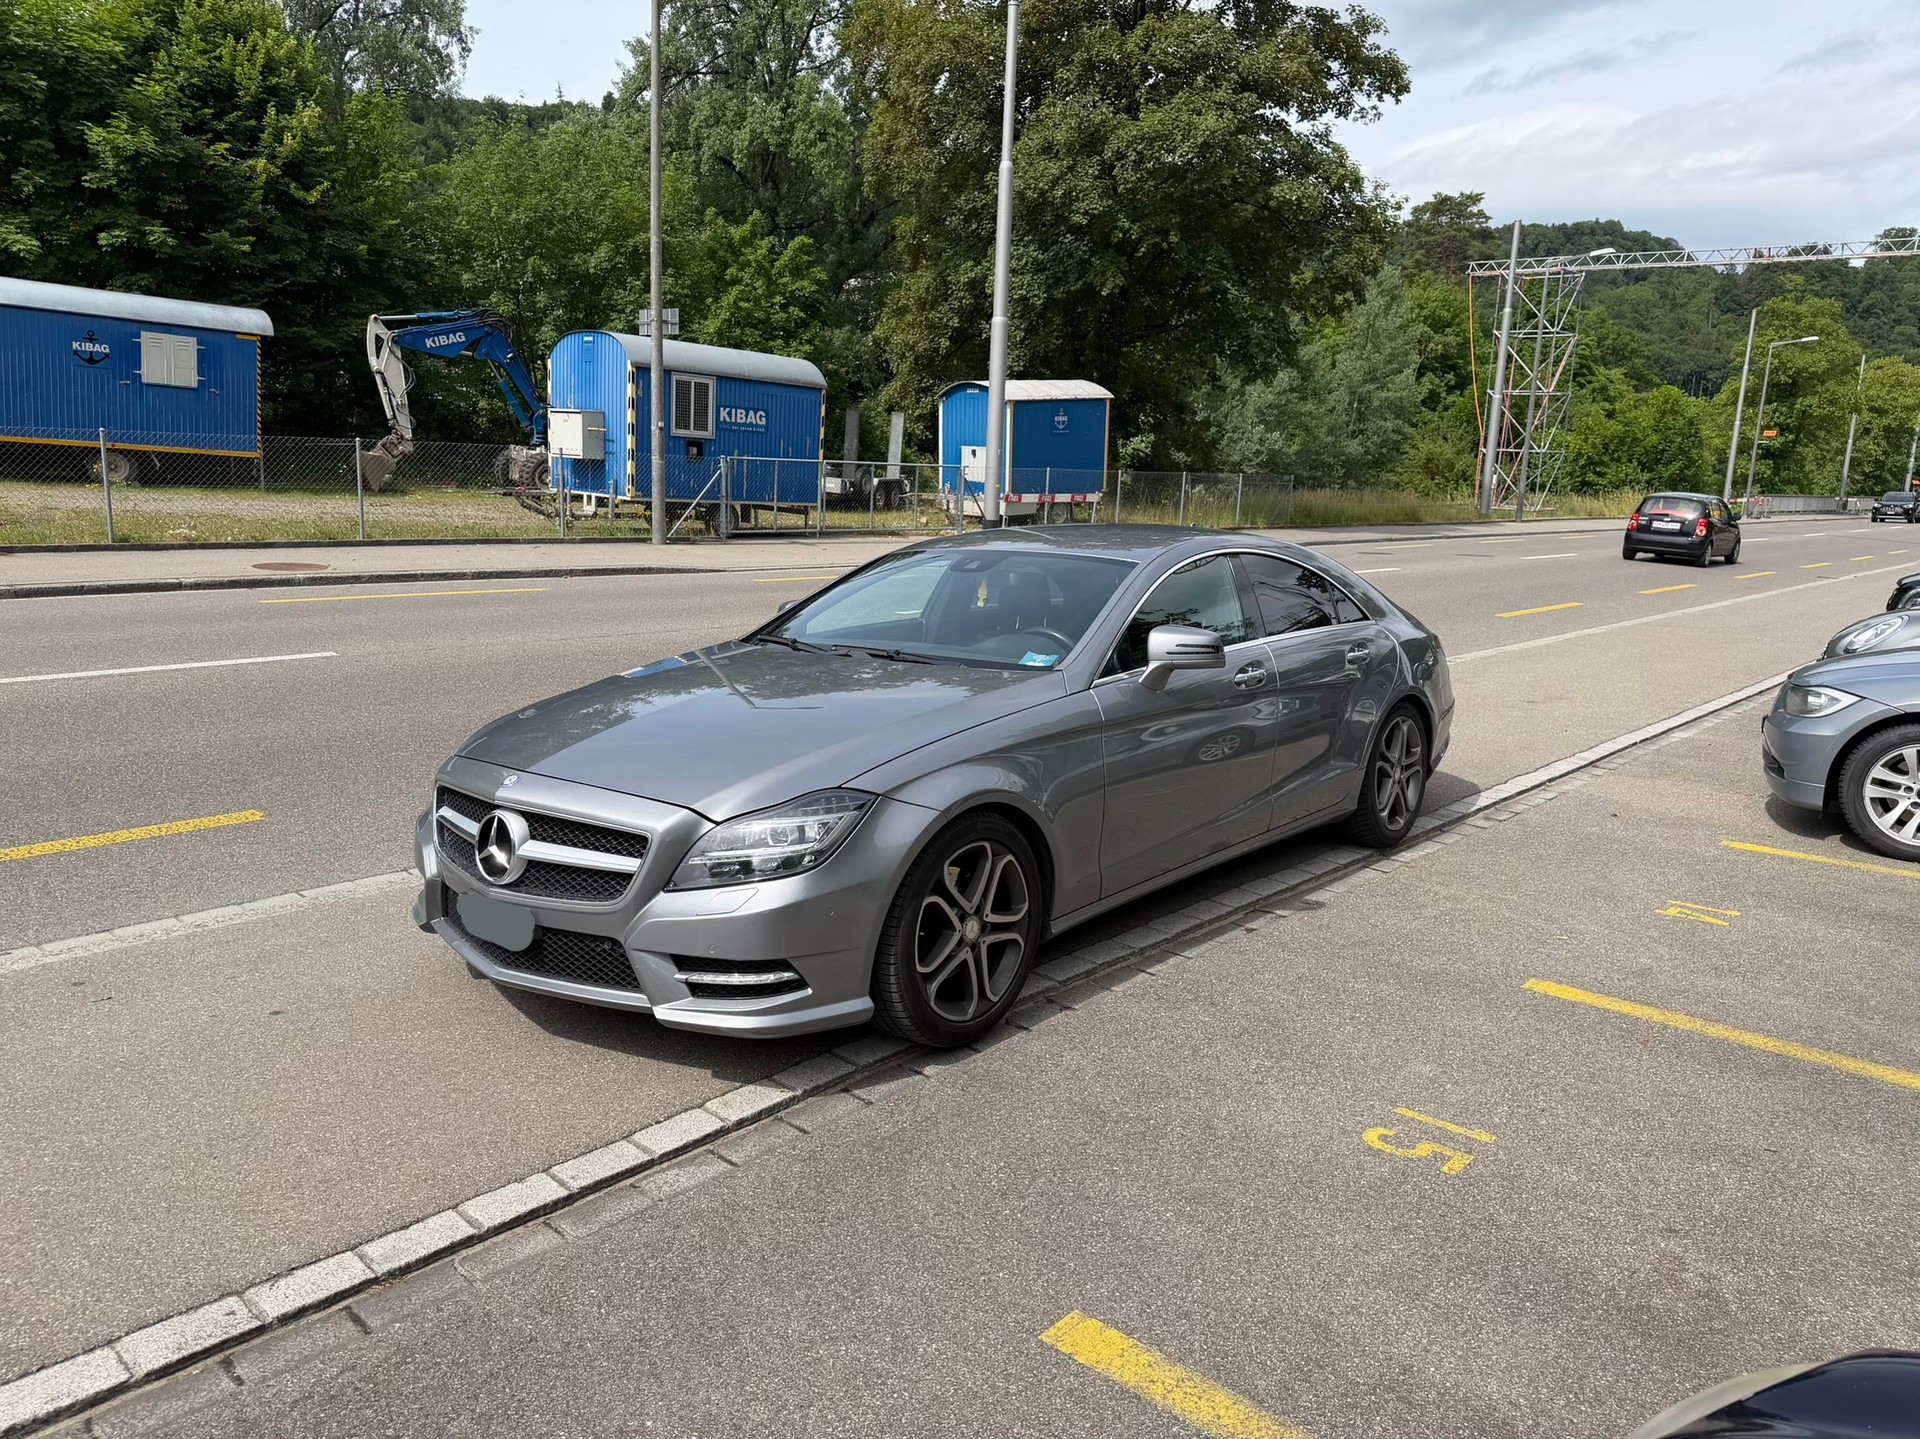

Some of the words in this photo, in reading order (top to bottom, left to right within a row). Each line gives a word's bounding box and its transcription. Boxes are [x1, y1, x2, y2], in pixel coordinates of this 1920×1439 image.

[72, 341, 110, 353] KIBAG
[425, 332, 466, 348] KIBAG
[720, 407, 766, 426] KIBAG
[1362, 1107, 1496, 1175] 15
